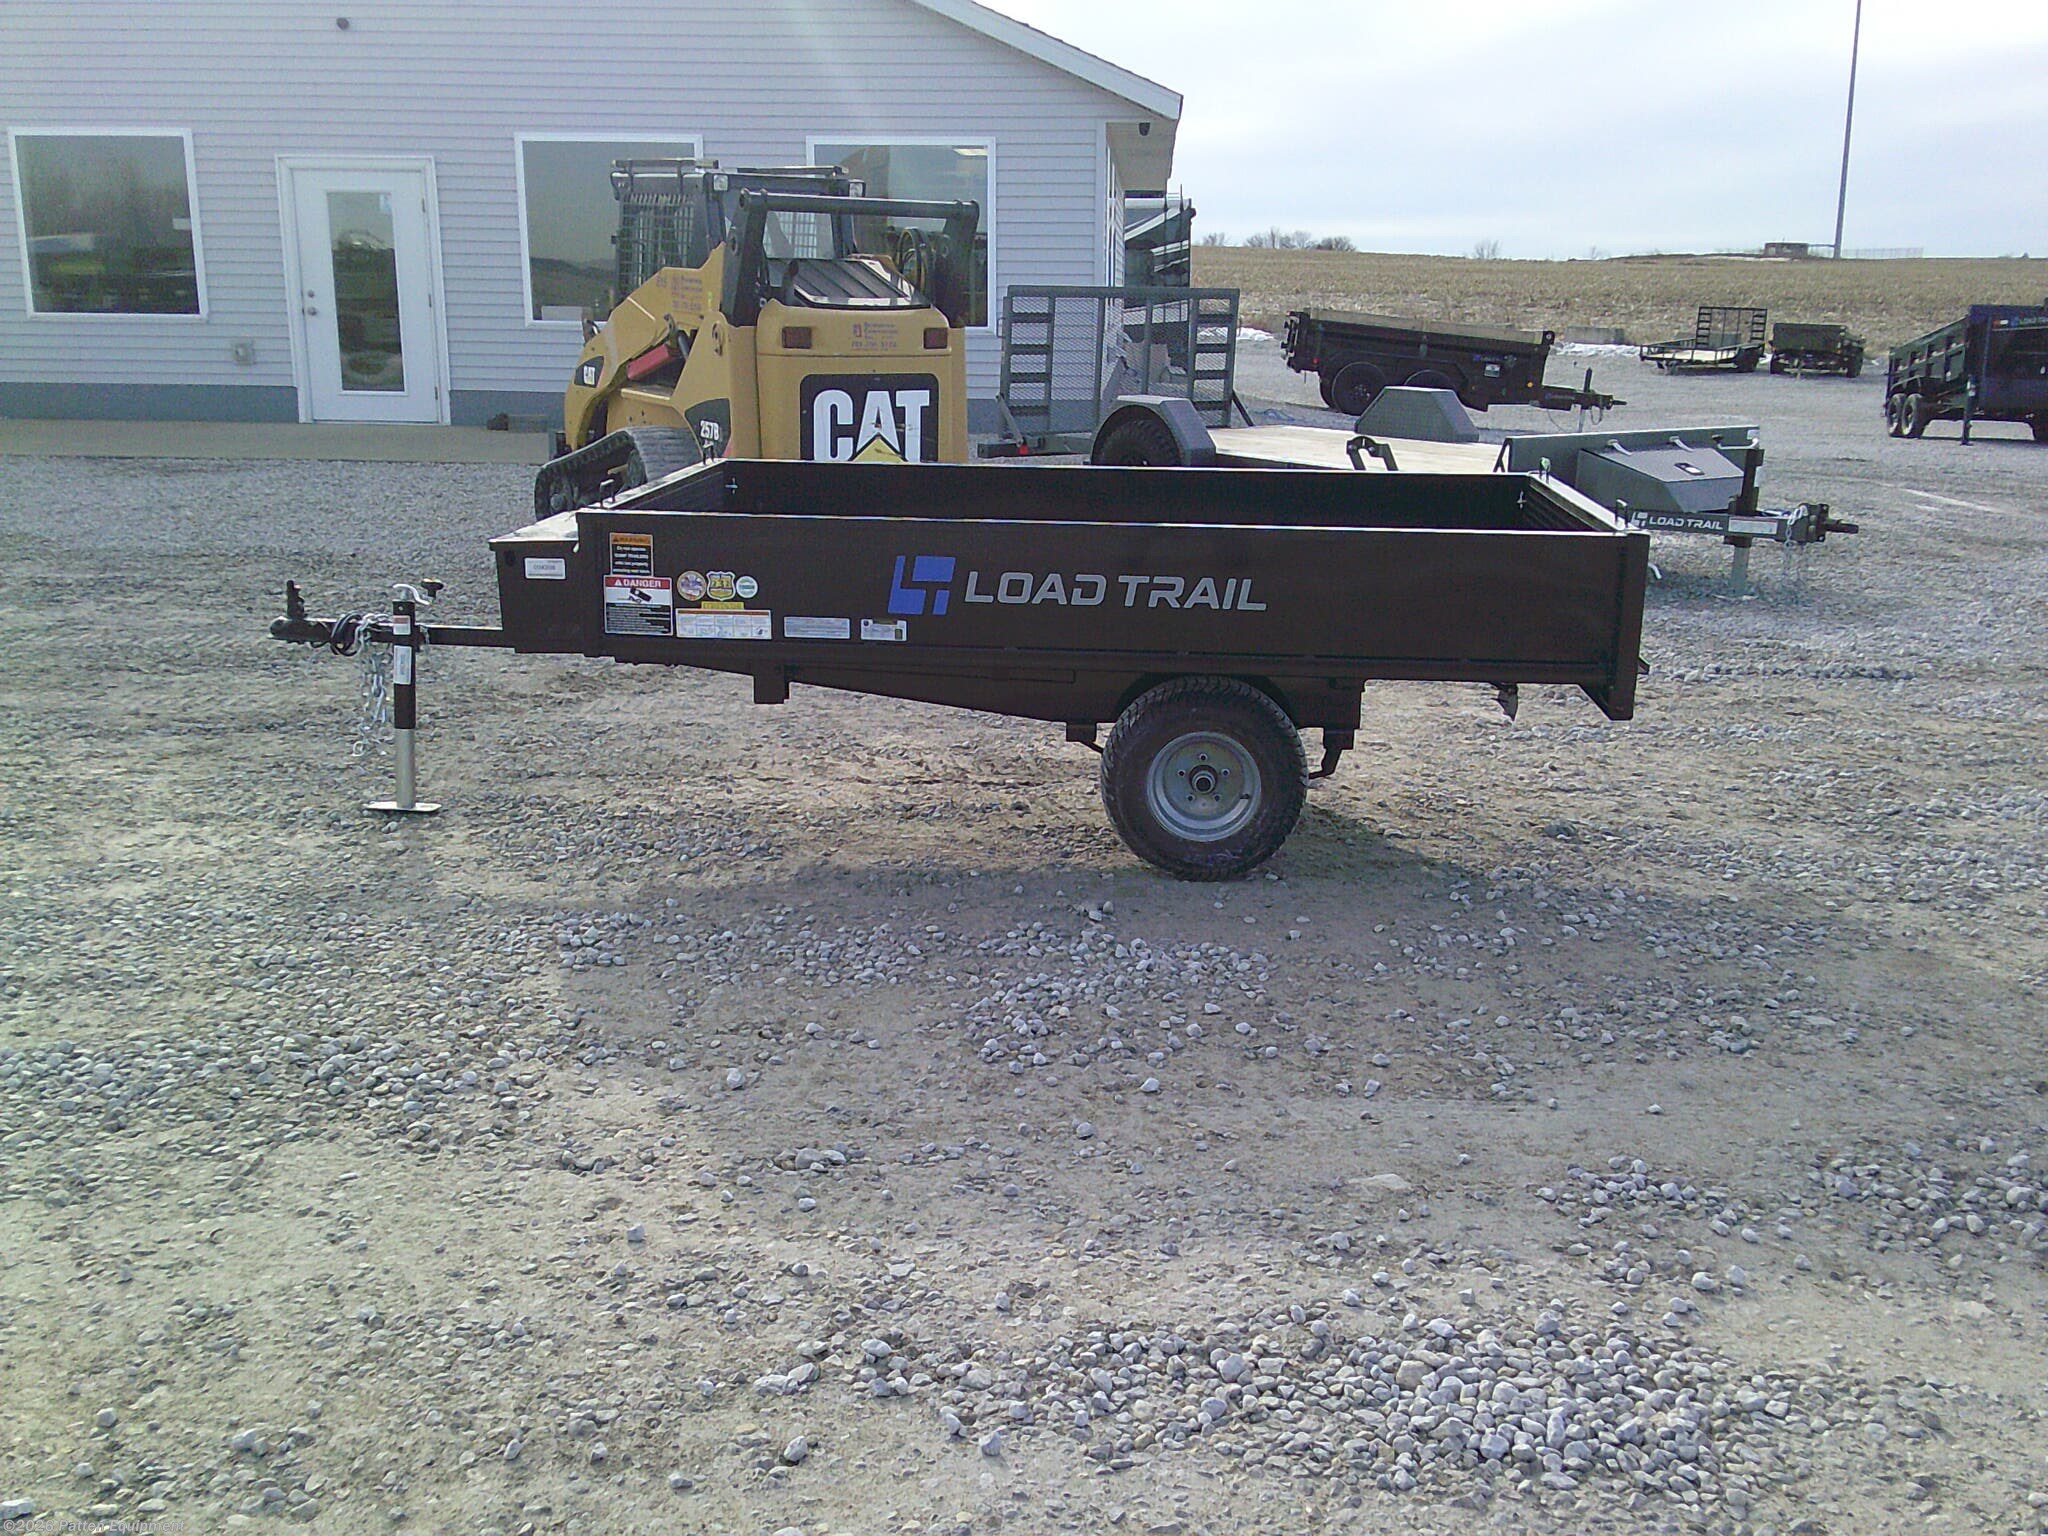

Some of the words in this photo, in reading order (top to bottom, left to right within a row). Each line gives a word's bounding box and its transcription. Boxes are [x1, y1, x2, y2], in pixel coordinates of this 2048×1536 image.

[700, 420, 720, 441] 257B
[813, 389, 930, 463] CAT
[1649, 516, 1684, 527] LOAD
[1687, 519, 1724, 530] TRAIL
[623, 578, 662, 588] DANGER
[964, 571, 1107, 606] LOAD
[1119, 575, 1267, 612] TRAIL
